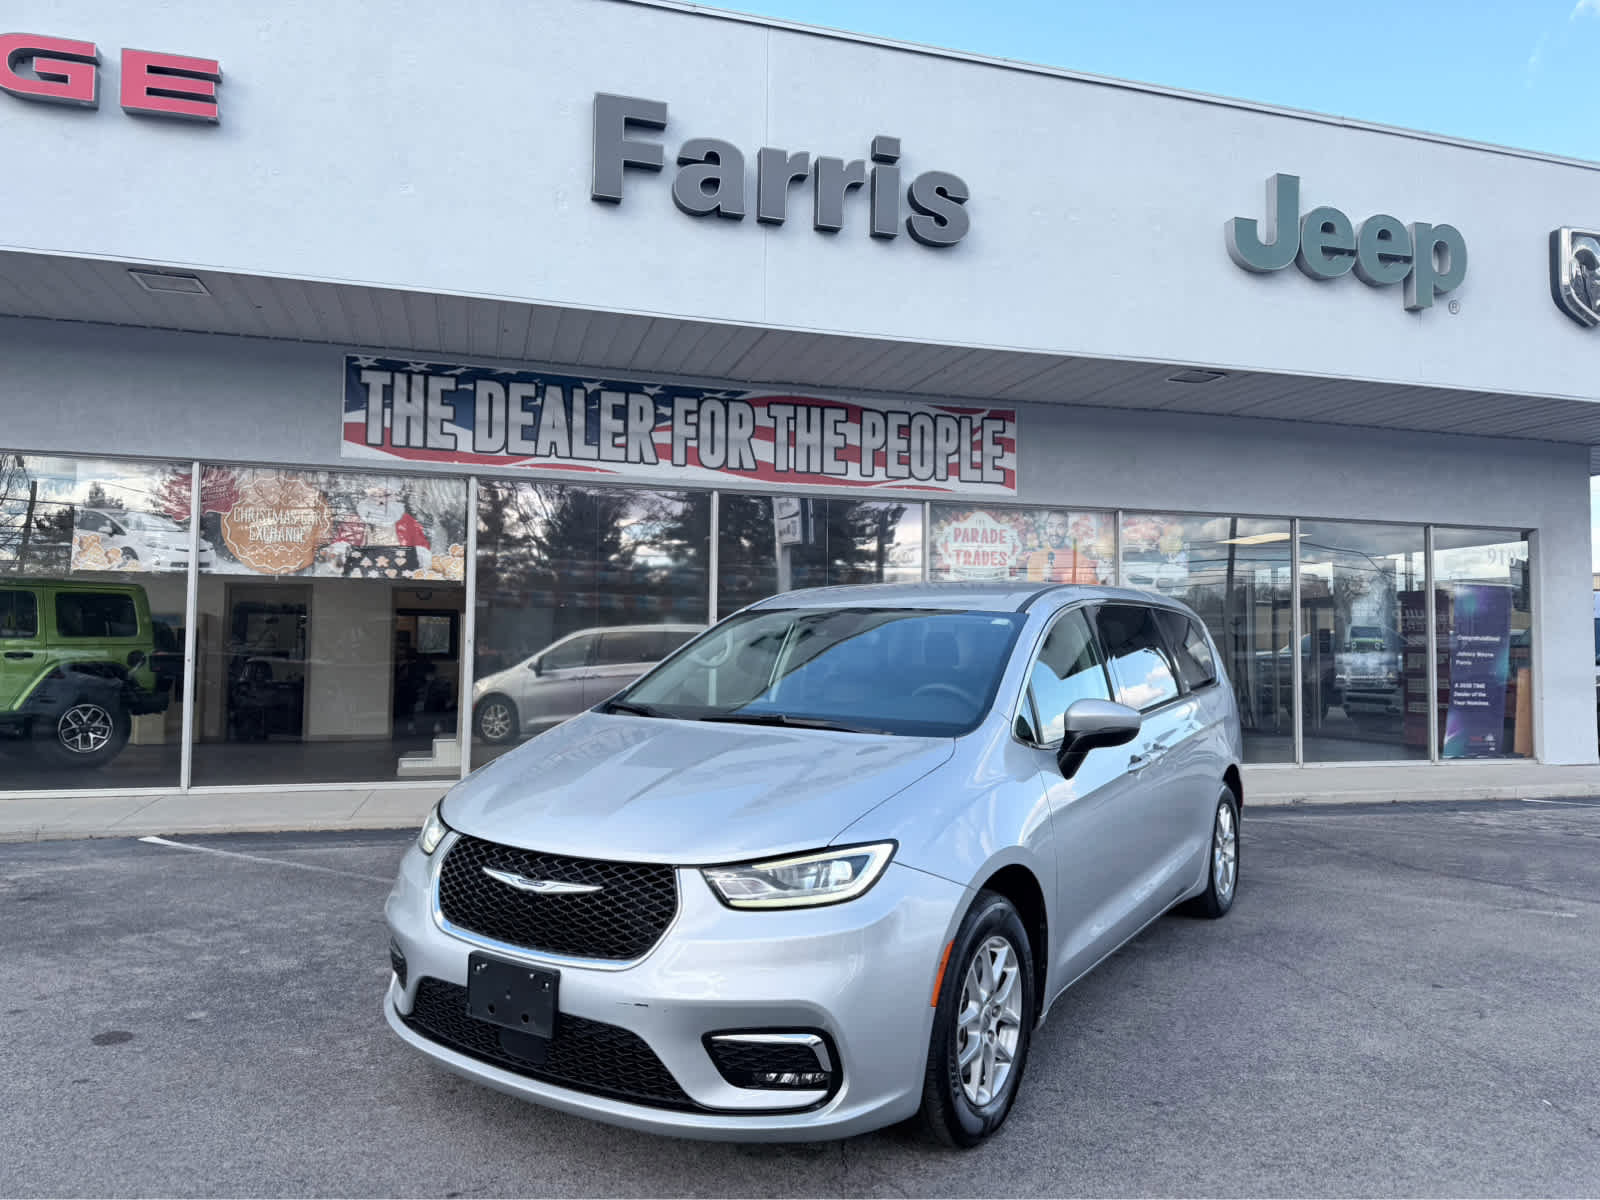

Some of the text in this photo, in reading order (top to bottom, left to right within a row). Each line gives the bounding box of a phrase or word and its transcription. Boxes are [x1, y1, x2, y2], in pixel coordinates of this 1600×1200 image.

[0, 32, 222, 127] GE
[591, 92, 970, 248] Farris
[1224, 173, 1468, 312] Jeep
[360, 368, 1006, 484] THE DEALER FOR THE PEOPLE
[233, 506, 297, 525] CHRISTMAS
[249, 525, 306, 544] EXCHANGE
[953, 527, 1009, 544] PARADE
[952, 549, 1009, 567] TRADES
